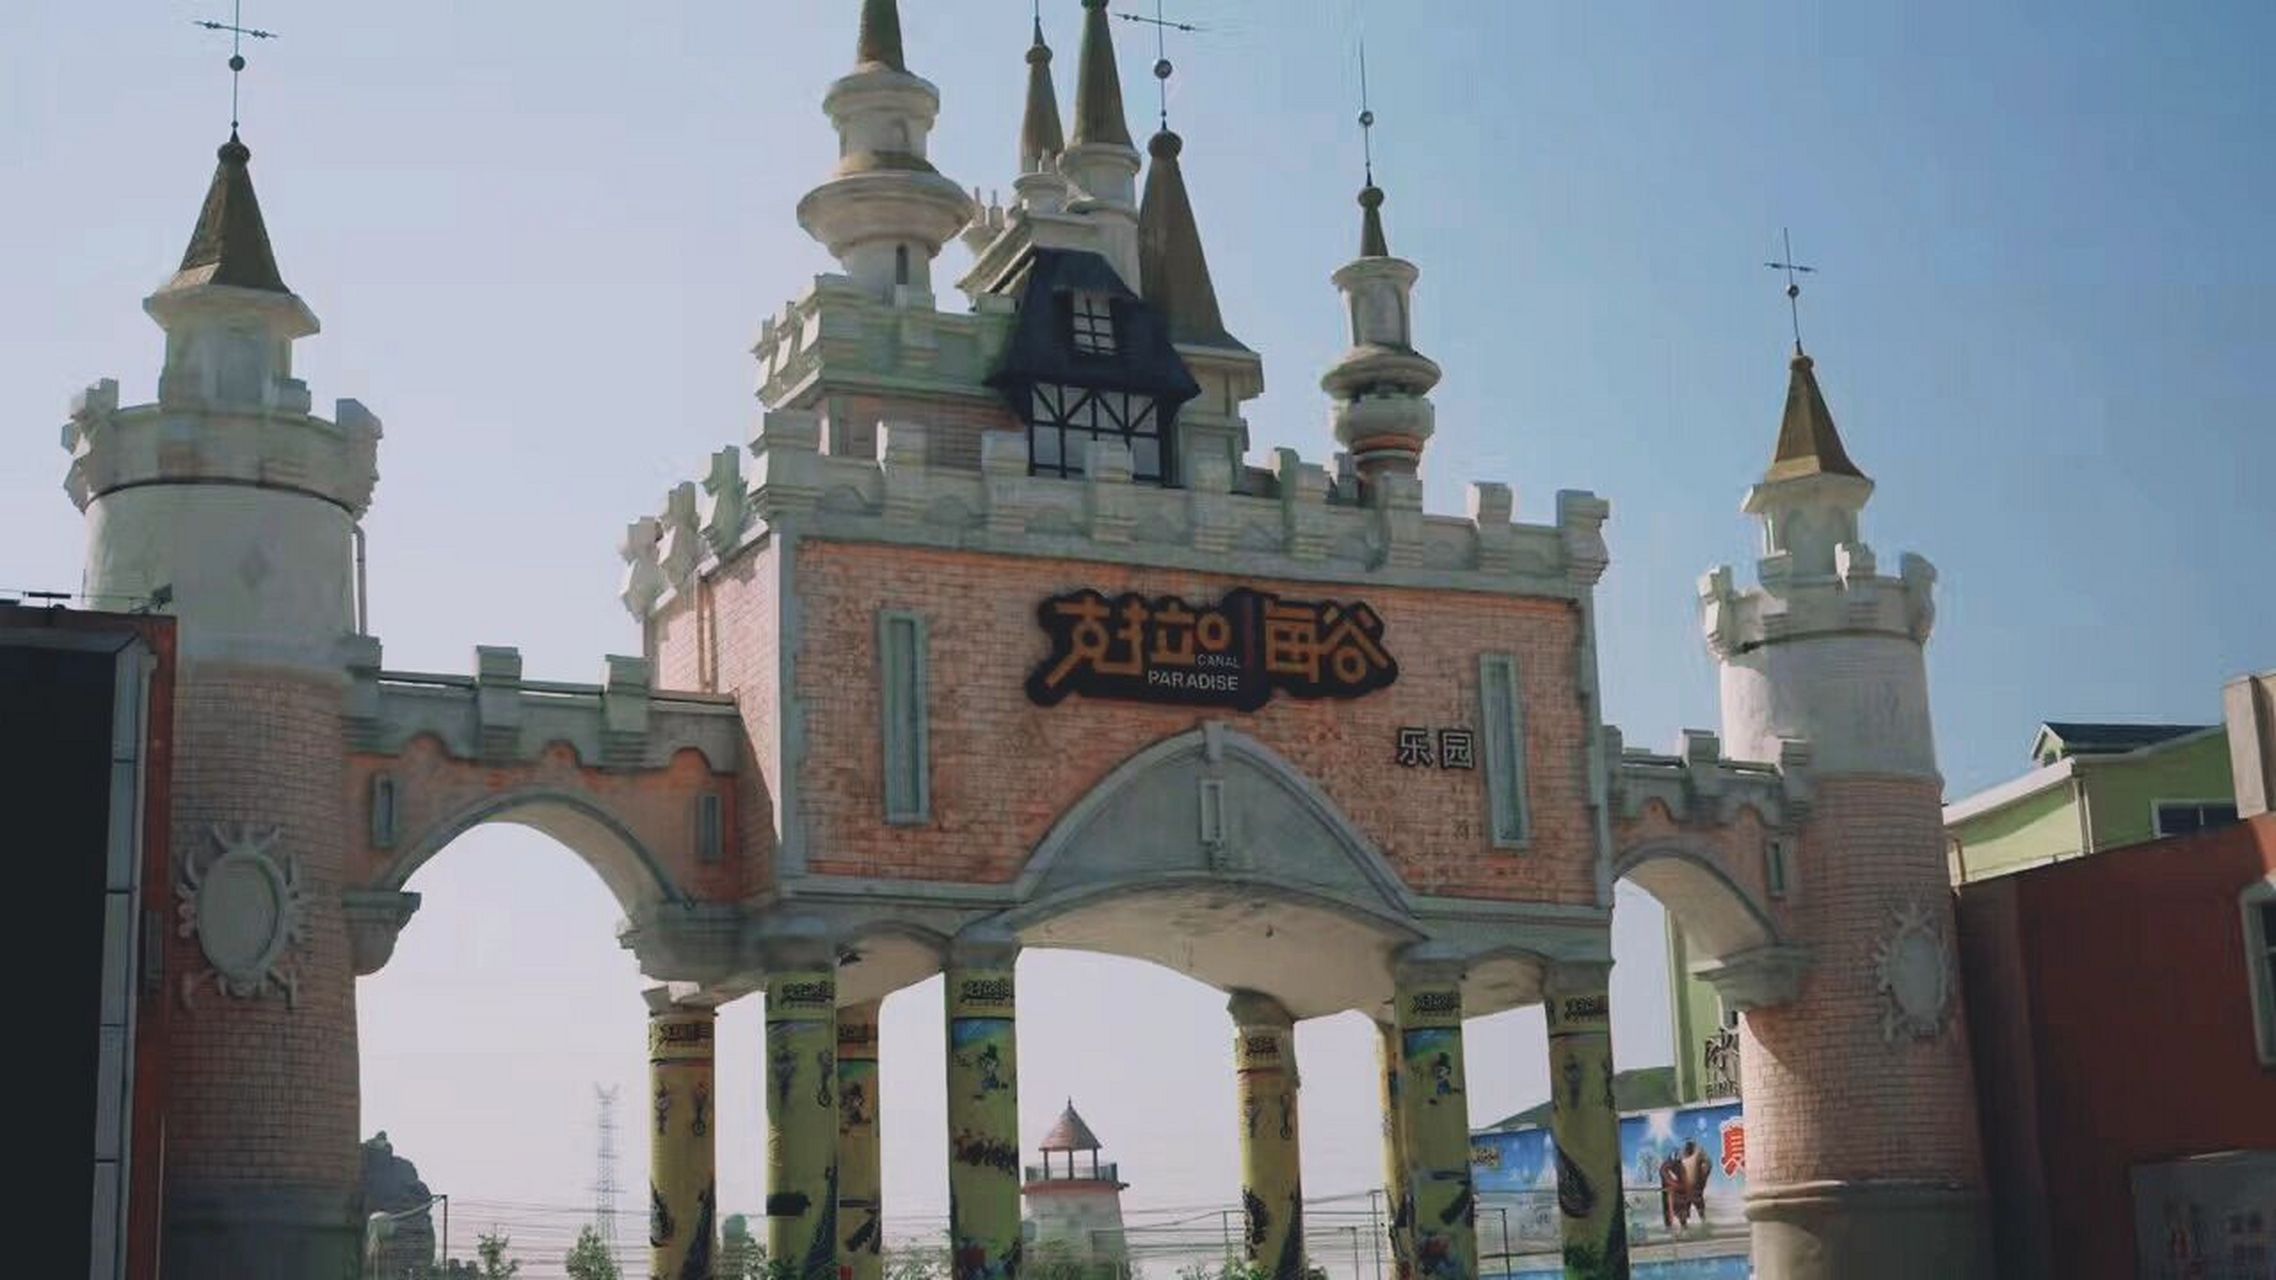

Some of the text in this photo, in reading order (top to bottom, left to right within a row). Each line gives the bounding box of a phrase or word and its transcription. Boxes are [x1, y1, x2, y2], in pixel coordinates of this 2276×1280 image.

[1197, 653, 1241, 669] CANAL
[1147, 670, 1239, 692] PARADISE
[1399, 728, 1474, 768] 乐园
